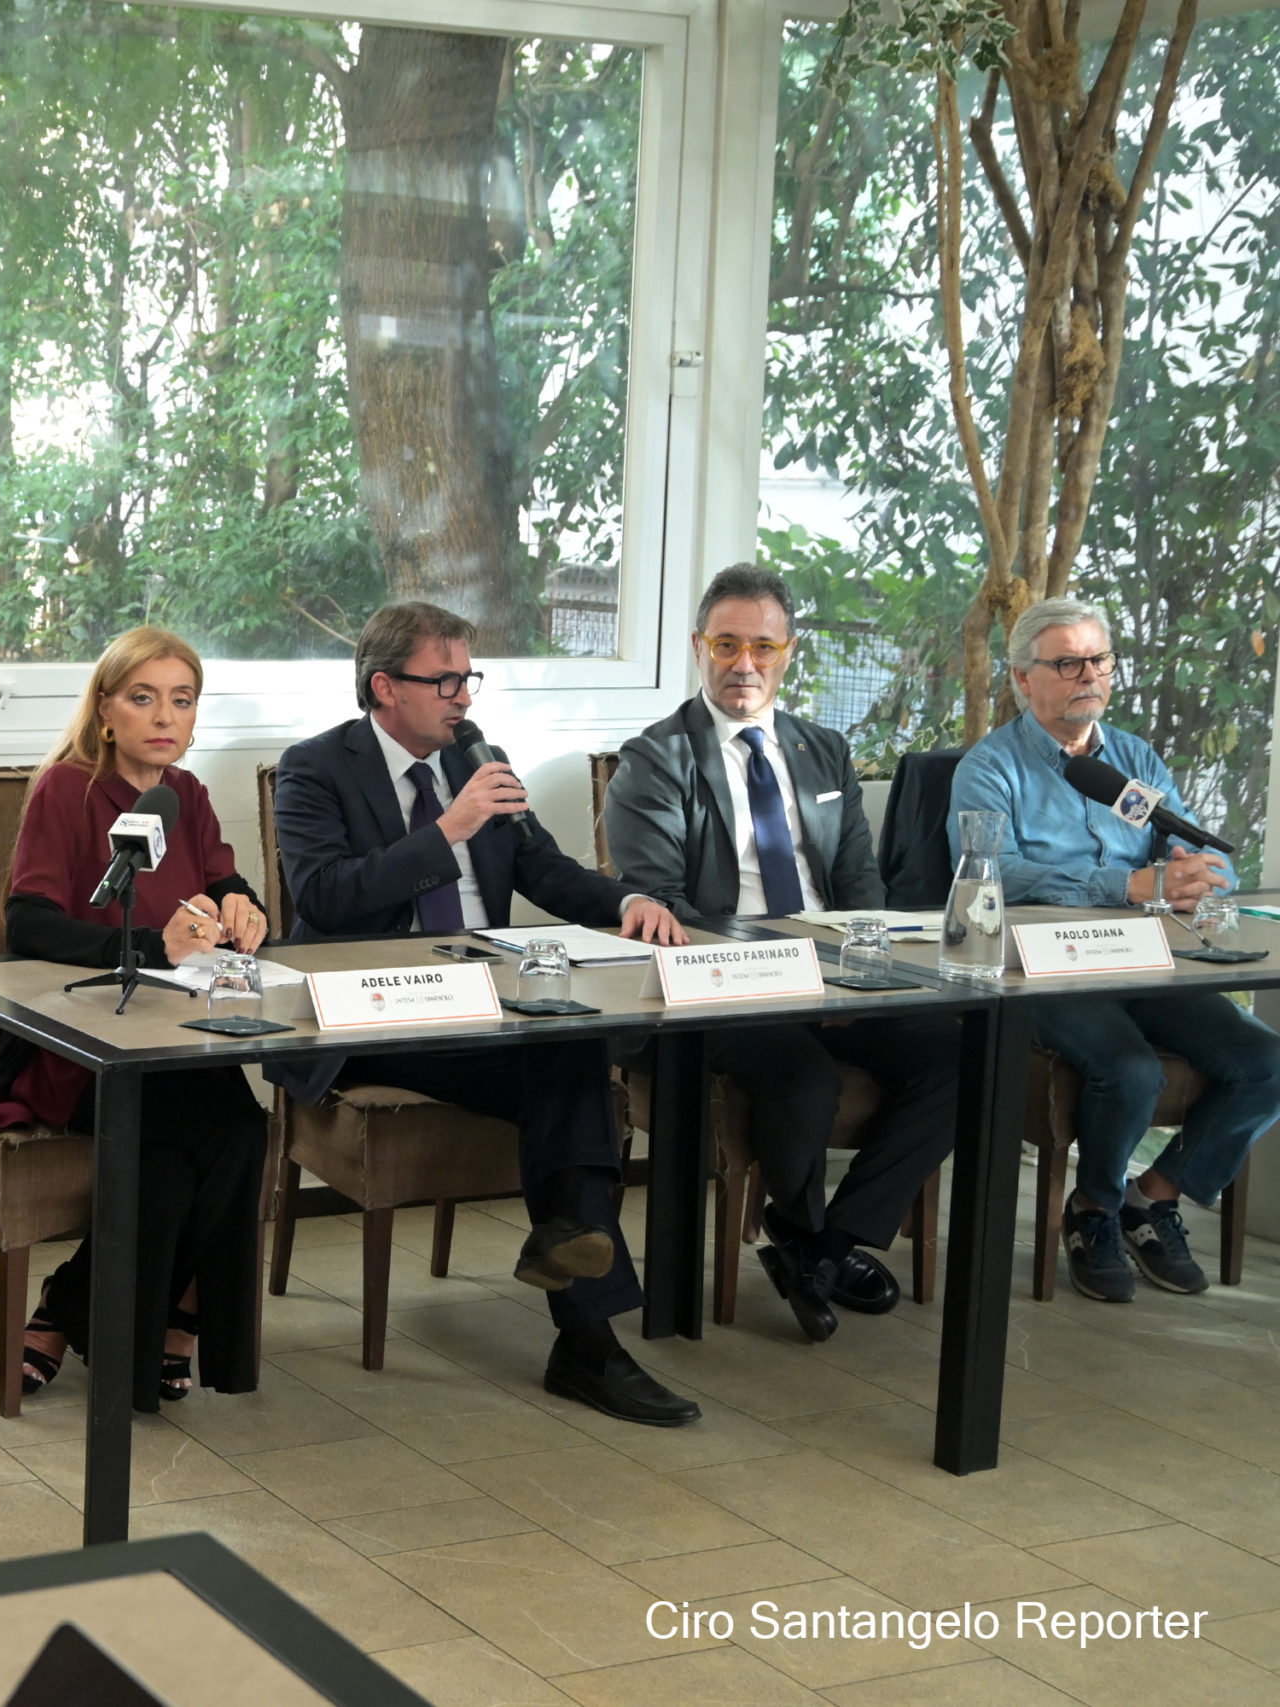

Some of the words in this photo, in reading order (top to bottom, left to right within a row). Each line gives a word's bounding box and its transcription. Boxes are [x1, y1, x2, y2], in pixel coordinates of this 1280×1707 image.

[1055, 929, 1090, 940] PAOLO
[1092, 928, 1125, 938] DIANA
[675, 951, 741, 966] FRANCESCO
[744, 947, 800, 961] FARINARO
[361, 976, 401, 988] ADELE
[404, 973, 443, 986] VAIRO
